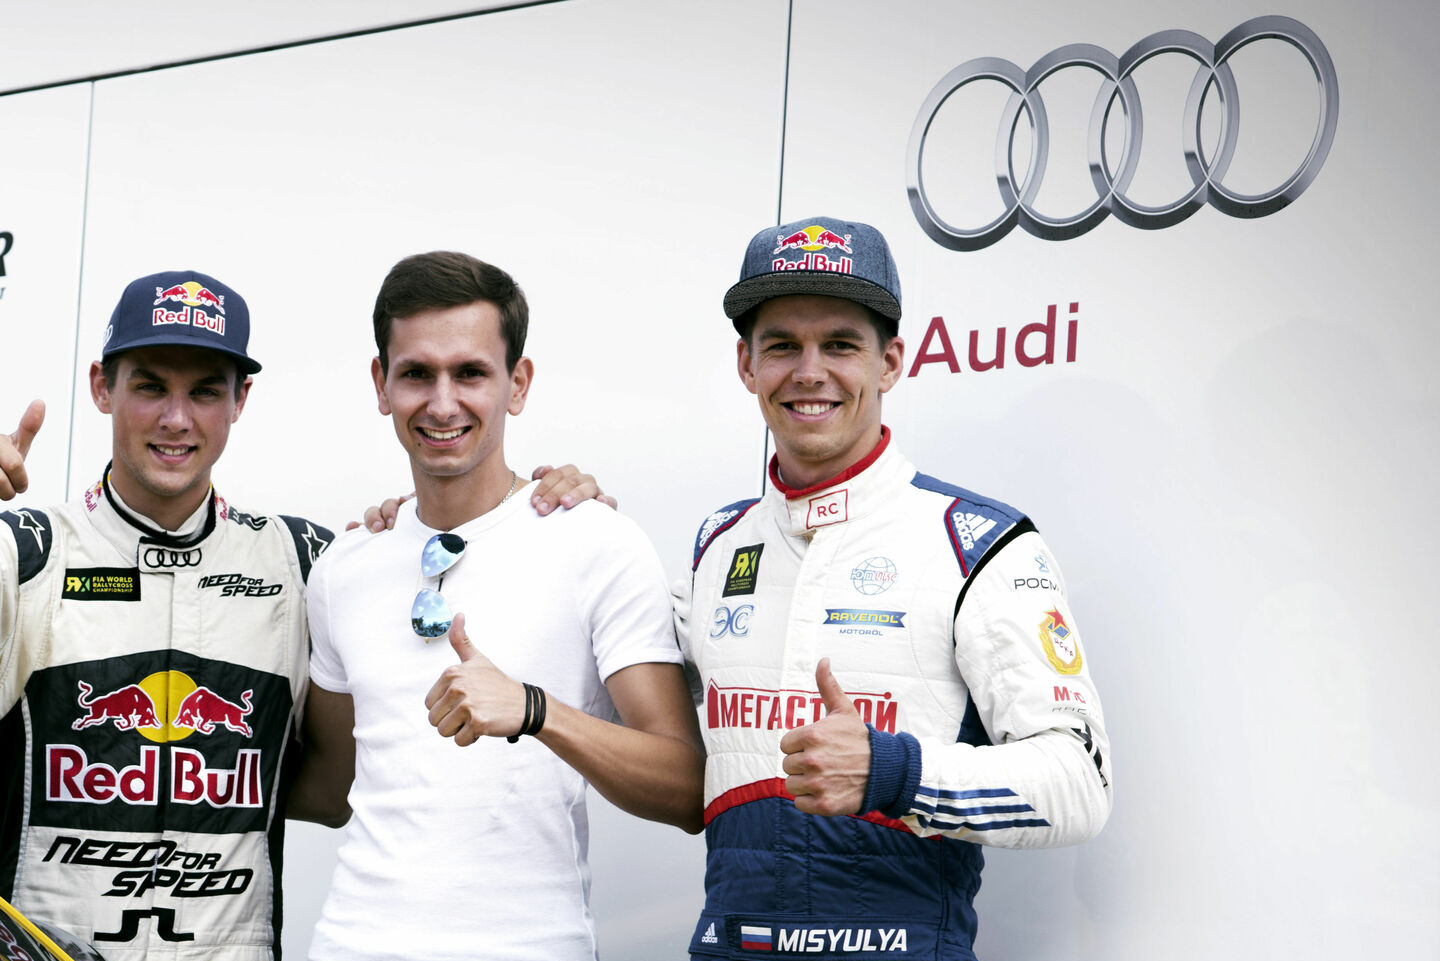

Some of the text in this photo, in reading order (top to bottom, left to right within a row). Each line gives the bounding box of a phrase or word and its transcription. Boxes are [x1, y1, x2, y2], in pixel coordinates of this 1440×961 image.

[773, 253, 853, 275] Red Bull
[153, 306, 226, 336] Red Bull
[907, 302, 1080, 378] Audi
[817, 502, 840, 518] RC
[952, 510, 975, 551] adidas
[198, 573, 243, 589] NEED
[219, 584, 284, 598] SPEED
[829, 611, 900, 625] RAVENOL
[46, 744, 263, 808] Red Bull
[42, 835, 222, 870] NEED FOR
[101, 867, 254, 898] SPEED
[777, 928, 908, 952] MISYULYA
